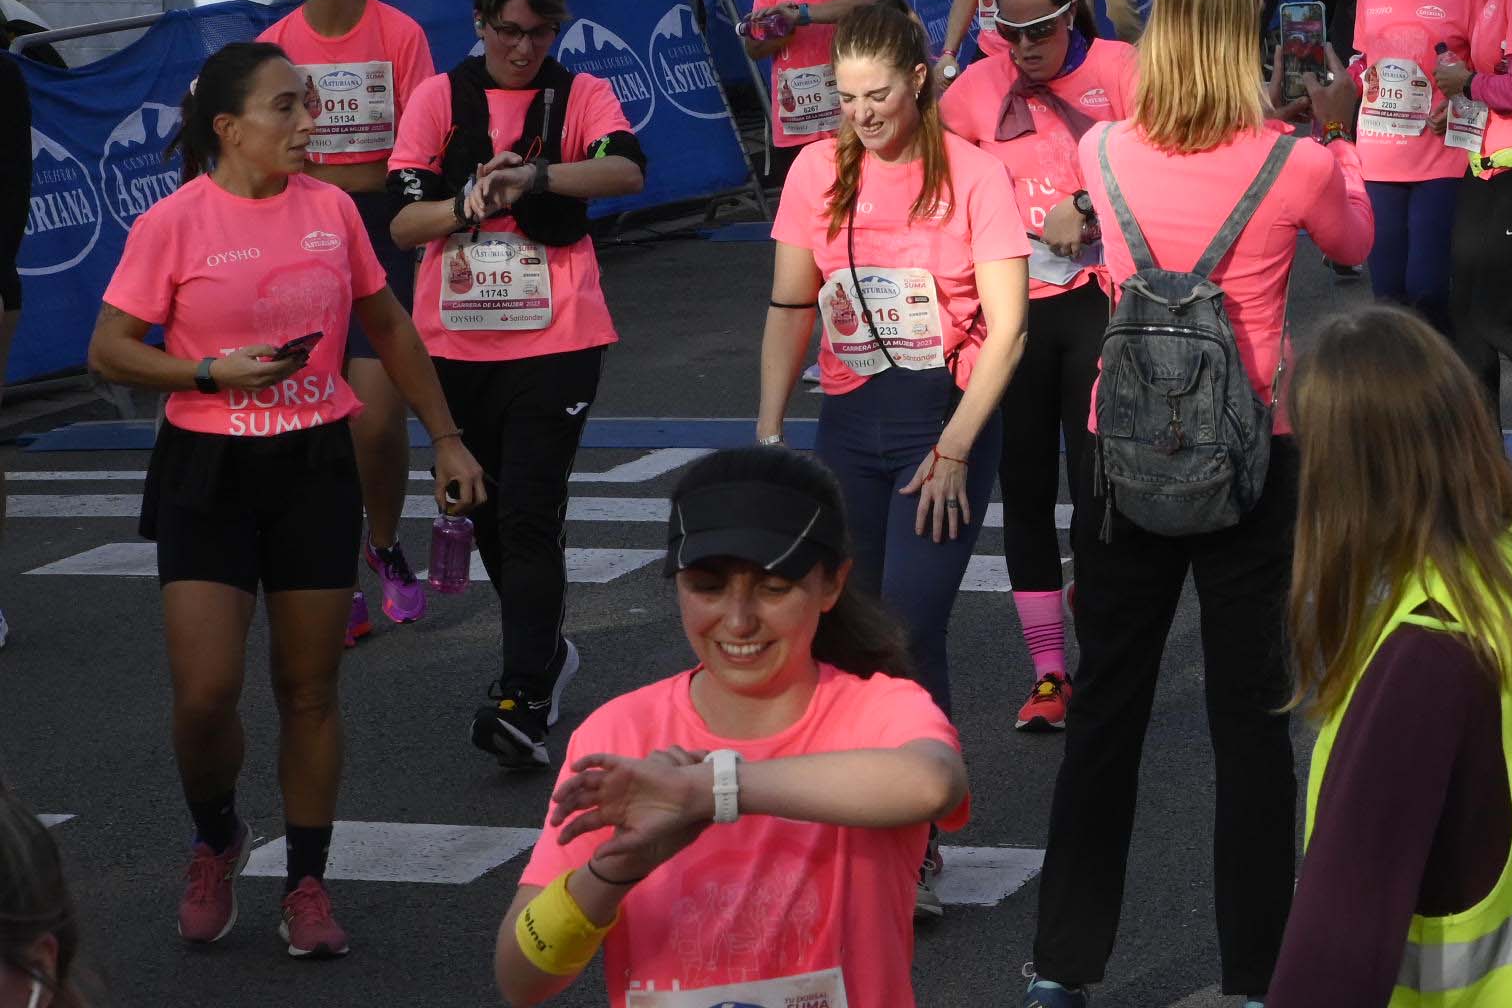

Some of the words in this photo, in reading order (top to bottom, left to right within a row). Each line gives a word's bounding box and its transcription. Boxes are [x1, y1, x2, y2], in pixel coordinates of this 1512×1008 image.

[797, 92, 822, 105] 016
[1380, 87, 1403, 100] 016
[325, 98, 359, 112] 016
[1381, 101, 1397, 110] 2203
[328, 114, 355, 124] 15134
[206, 248, 261, 267] OYSHO
[475, 270, 513, 285] 016
[904, 282, 927, 290] SUMA
[479, 289, 509, 298] 11743
[450, 314, 484, 324] OYSHO
[861, 307, 900, 324] 016
[893, 340, 914, 348] MUJER
[902, 352, 937, 362] Santander
[229, 411, 324, 437] SUMA
